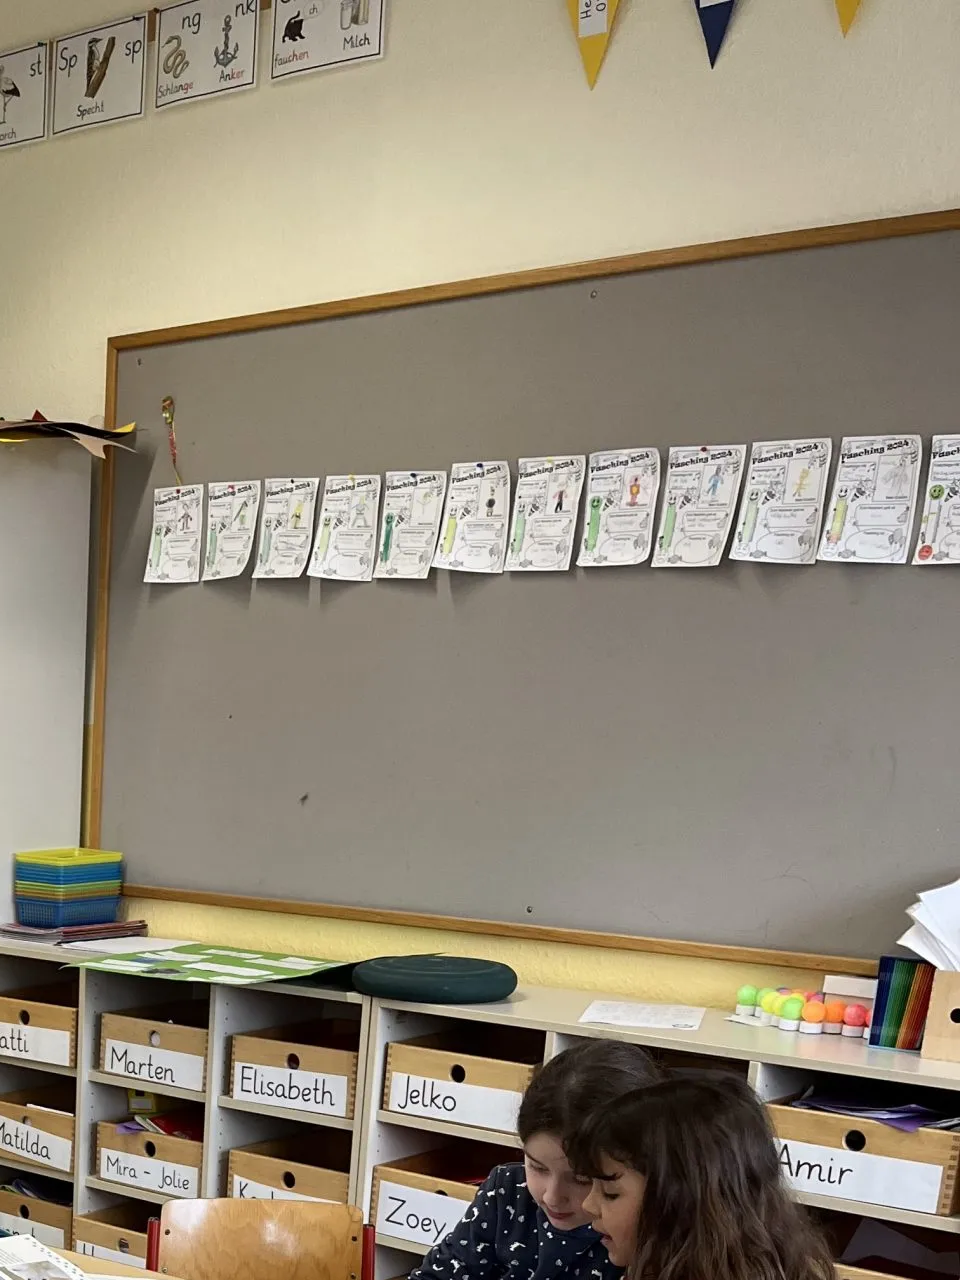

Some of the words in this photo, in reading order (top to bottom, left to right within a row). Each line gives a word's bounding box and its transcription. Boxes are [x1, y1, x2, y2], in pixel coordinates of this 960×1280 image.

[235, 0, 255, 17] nk
[181, 12, 201, 34] ng
[125, 38, 142, 66] sp
[343, 33, 370, 50] Milch
[29, 53, 43, 76] st
[58, 48, 78, 77] Sp
[274, 50, 309, 68] fauchen
[219, 69, 244, 83] Anker
[157, 80, 194, 99] Schlange
[77, 102, 104, 120] Specht
[110, 1046, 176, 1083] Marten
[240, 1065, 335, 1107] Elisabeth
[397, 1076, 457, 1113] Jelko
[106, 1156, 138, 1179] Mira
[158, 1166, 190, 1190] Jolie
[778, 1143, 853, 1185] Amir
[384, 1196, 447, 1243] Zoey
